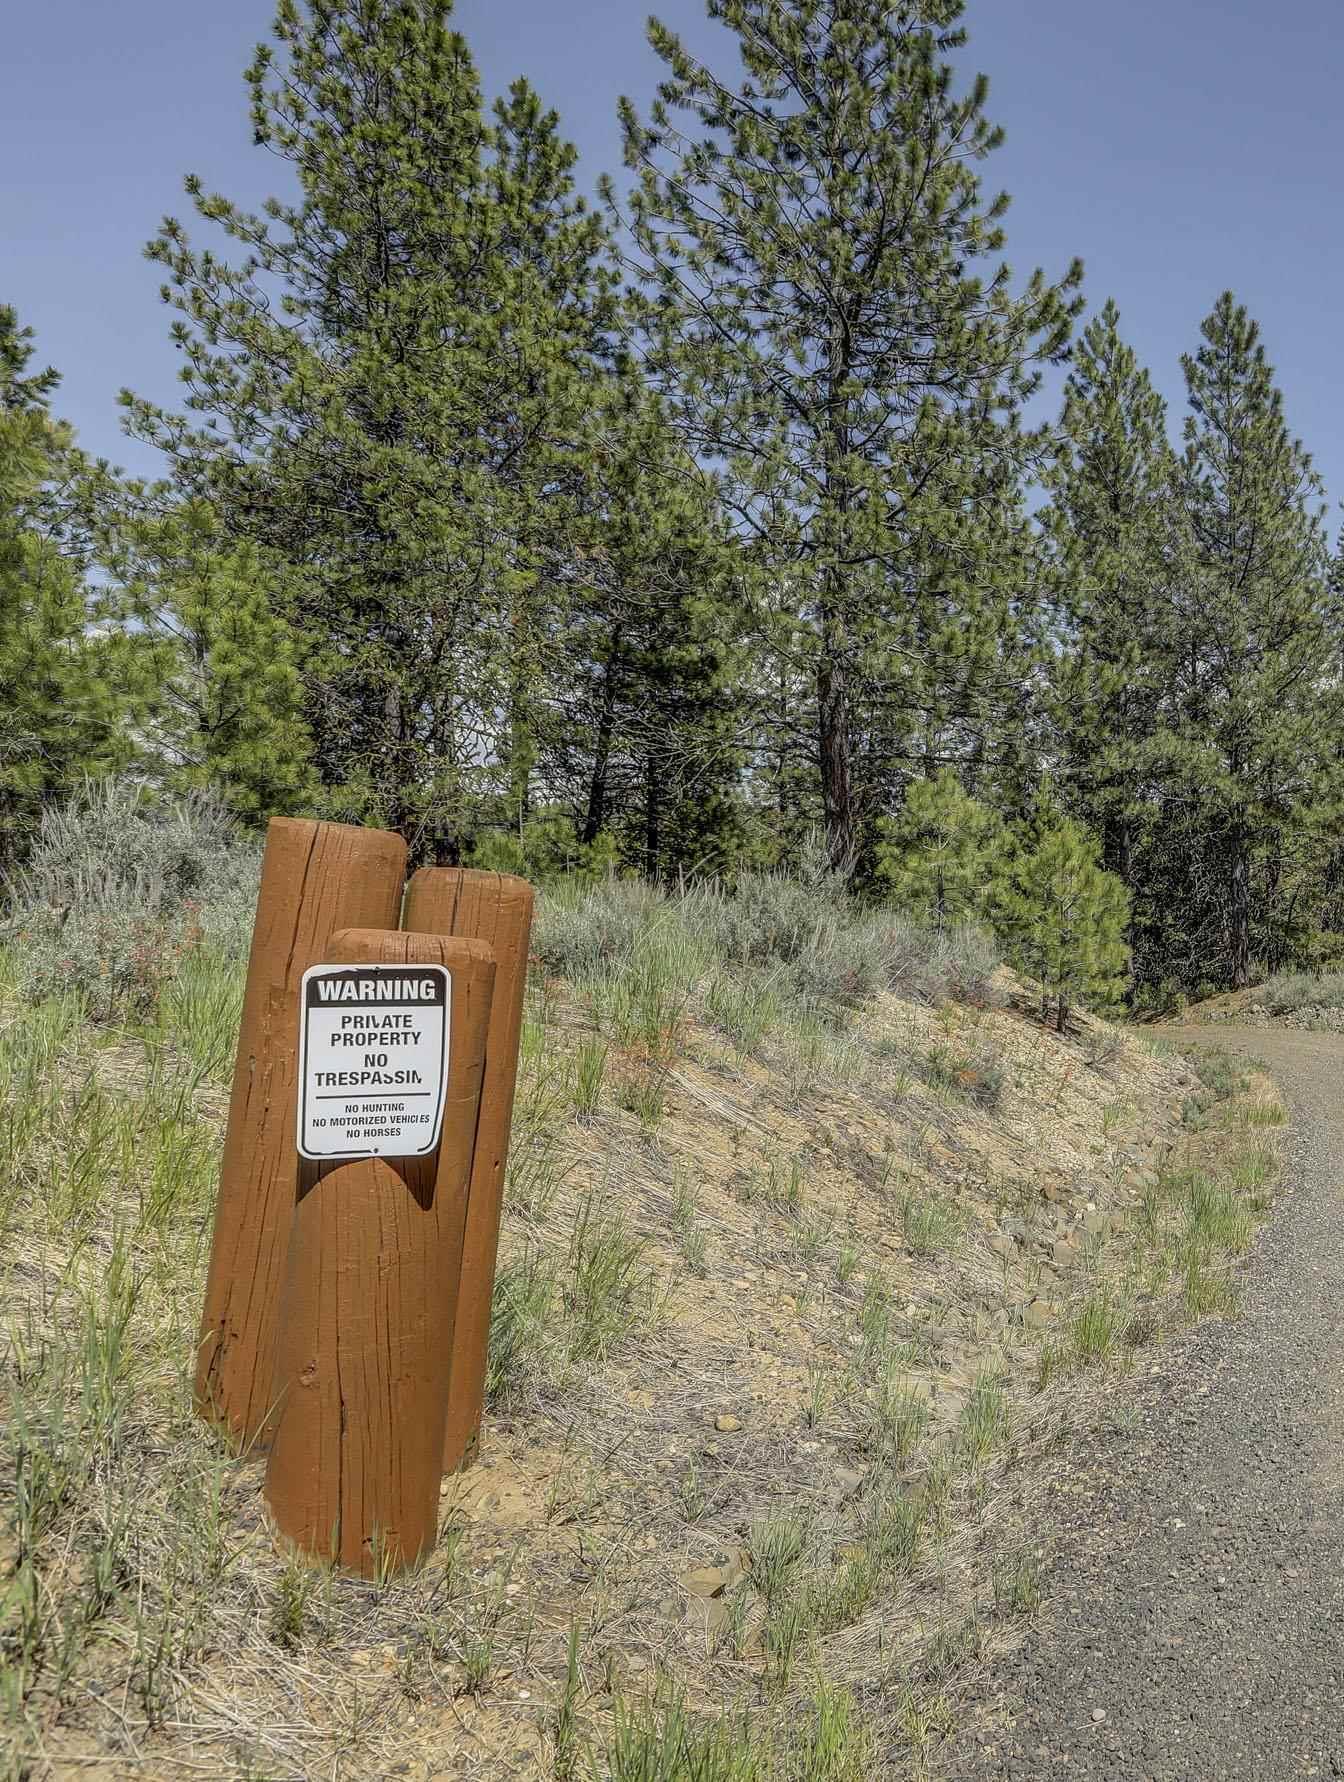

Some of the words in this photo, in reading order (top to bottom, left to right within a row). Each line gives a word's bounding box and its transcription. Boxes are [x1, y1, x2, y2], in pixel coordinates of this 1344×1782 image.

[318, 979, 436, 1001] WARNING
[341, 1015, 412, 1029] PRIVATE
[331, 1032, 421, 1047] PROPERTY
[364, 1054, 388, 1067] NO
[345, 1104, 359, 1112] NO
[362, 1103, 404, 1112] HUNTING
[312, 1119, 326, 1127] NO
[330, 1116, 386, 1126] MOTORIZED
[346, 1130, 360, 1138] NO
[363, 1128, 401, 1137] HORSES
